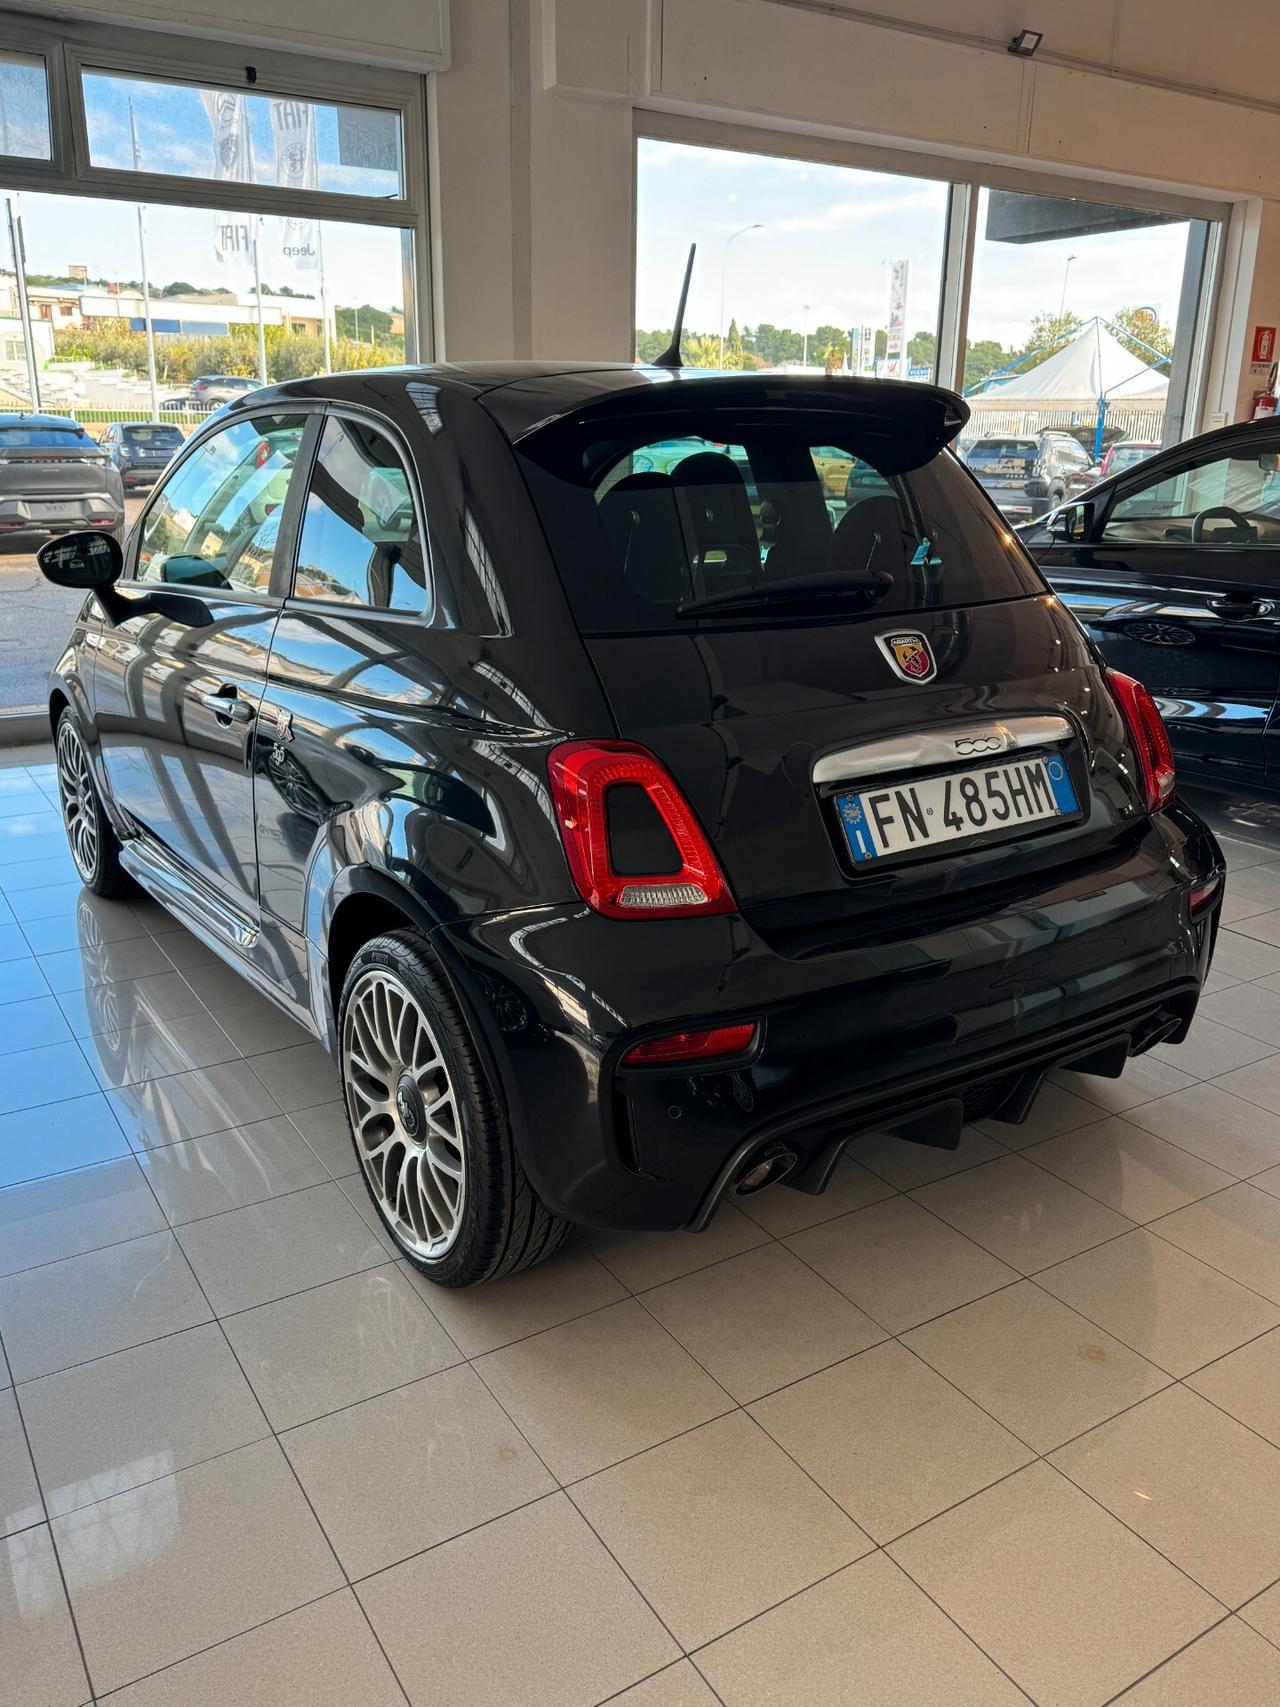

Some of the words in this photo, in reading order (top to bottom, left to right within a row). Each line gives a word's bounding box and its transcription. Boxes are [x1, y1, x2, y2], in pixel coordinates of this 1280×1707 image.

[954, 736, 1001, 755] 500
[868, 787, 930, 848] FN
[943, 763, 1055, 832] 485HM
